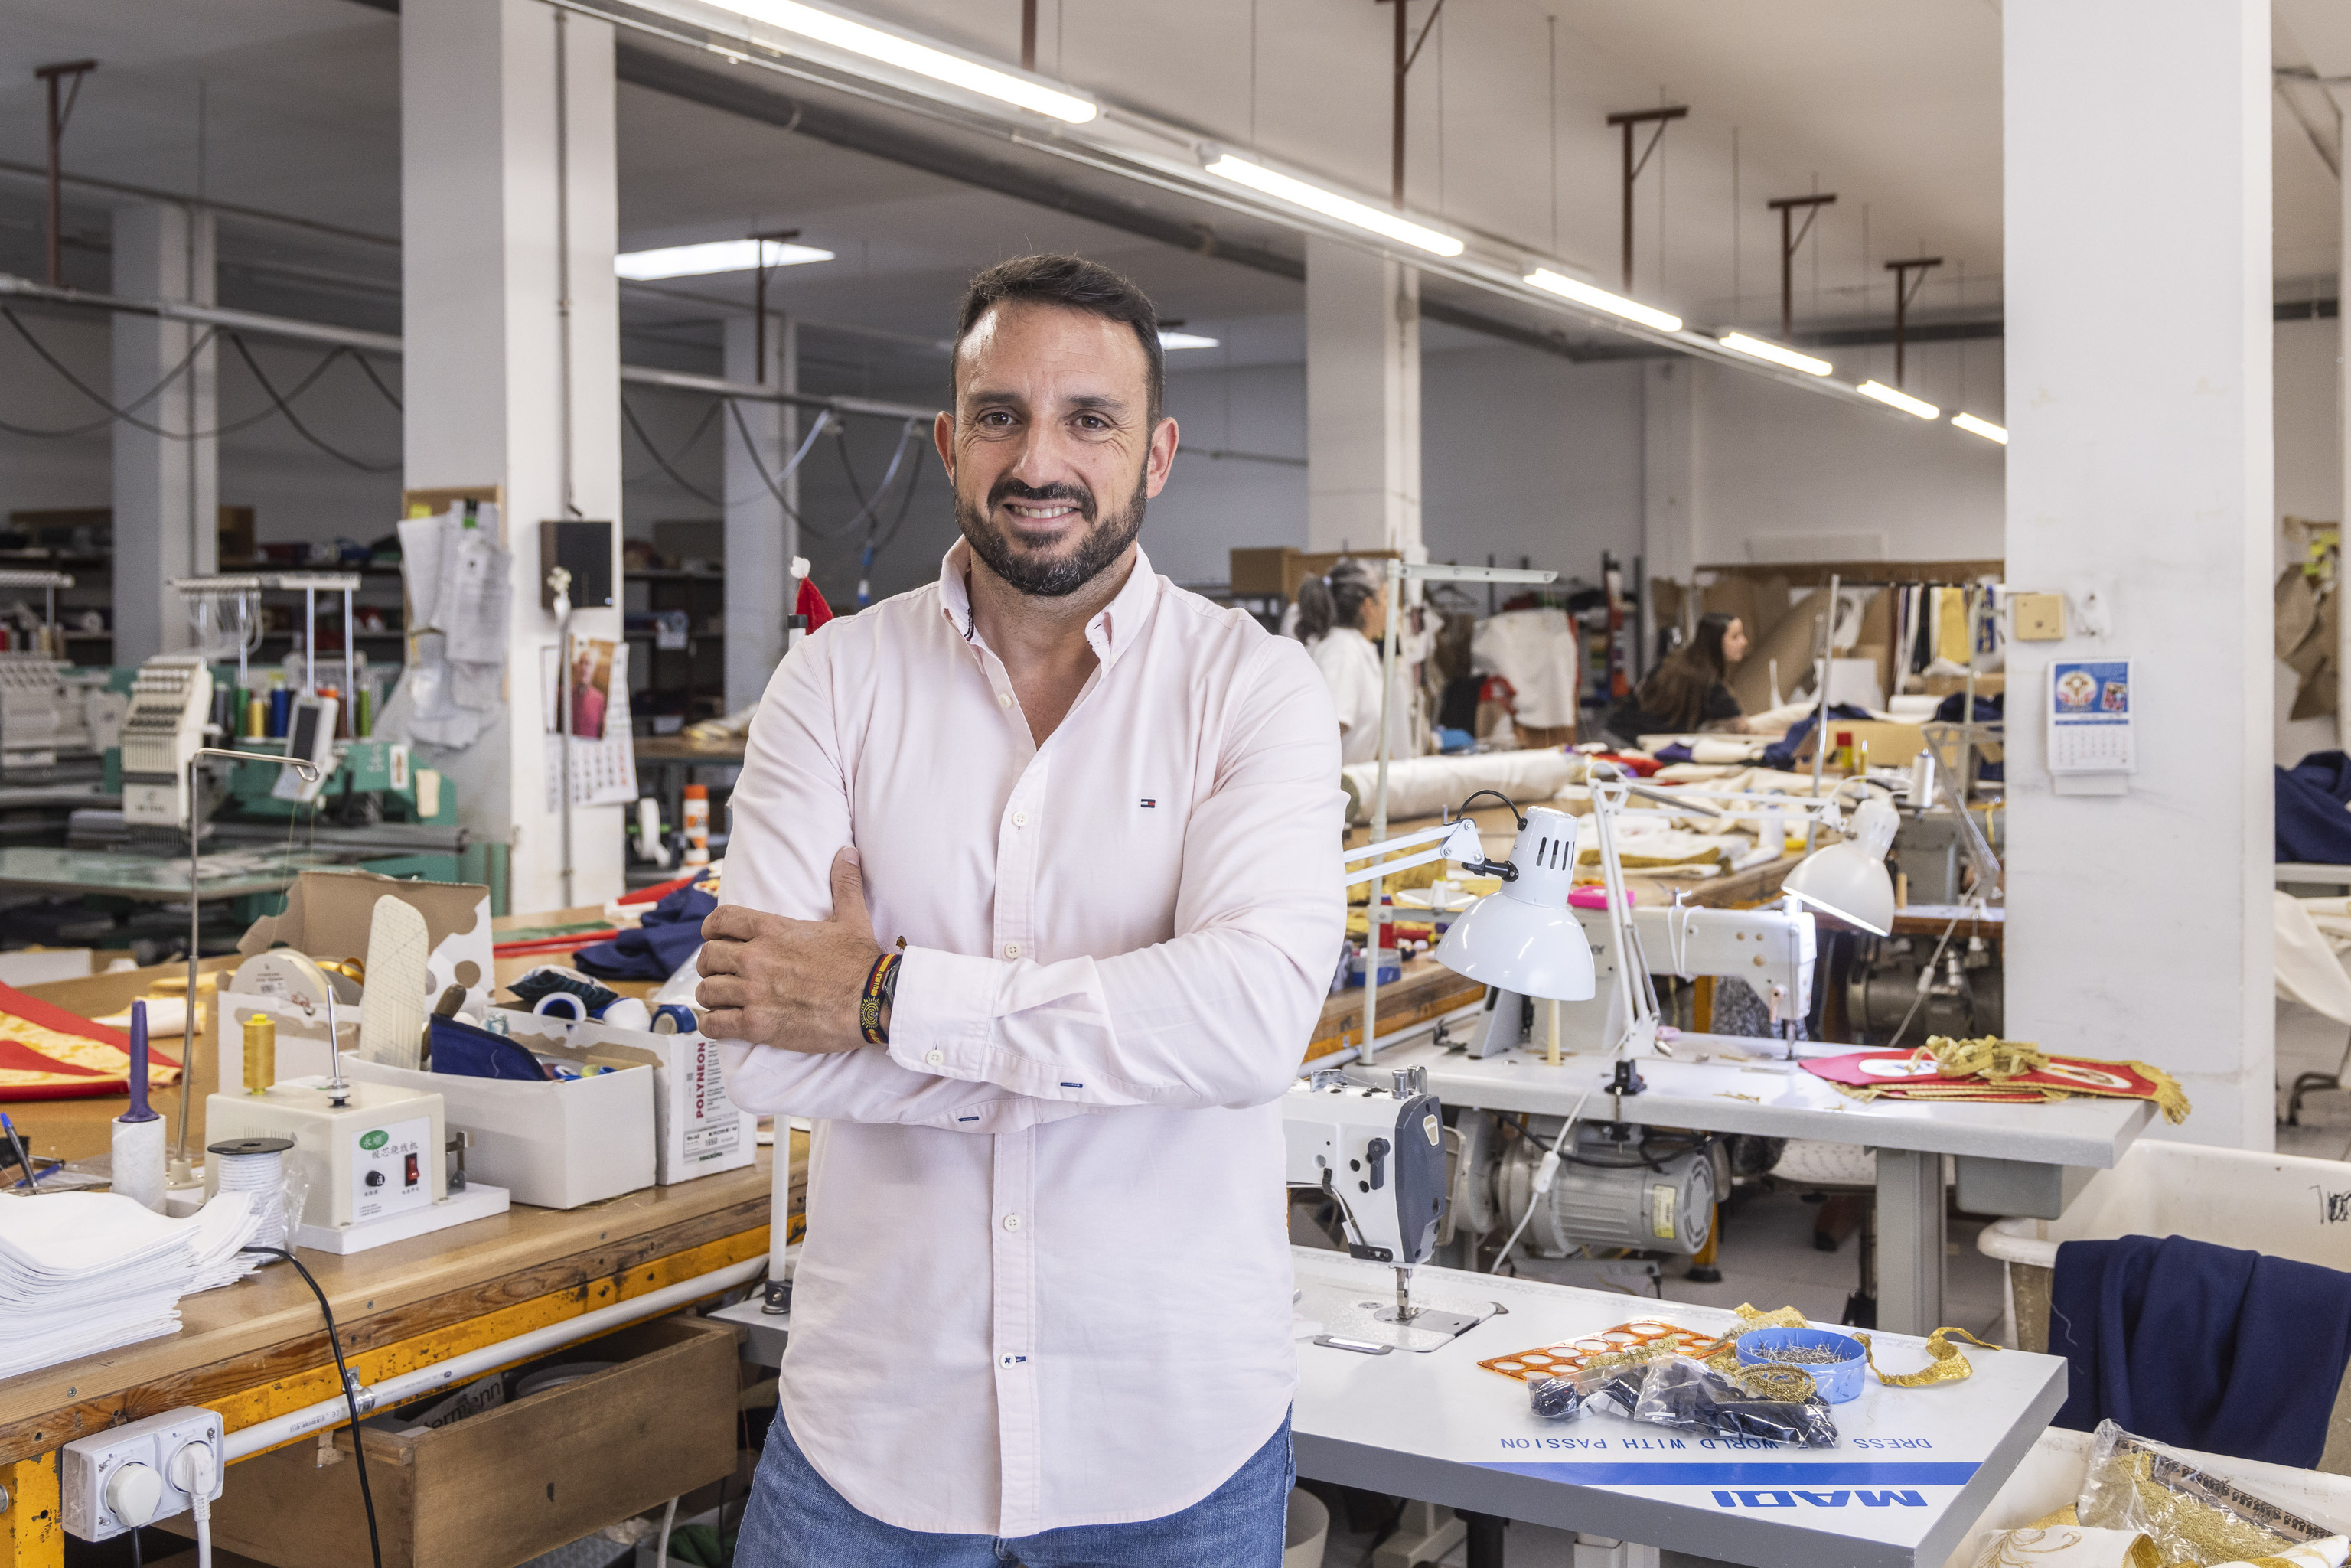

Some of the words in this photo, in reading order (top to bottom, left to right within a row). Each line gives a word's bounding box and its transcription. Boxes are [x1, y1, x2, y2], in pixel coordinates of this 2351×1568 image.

[872, 970, 884, 991] PILAR
[696, 1042, 706, 1119] POLYNEON
[1500, 1438, 1608, 1449] PASSION
[1622, 1438, 1686, 1449] WITH
[1700, 1438, 1780, 1449] WORLD
[1852, 1438, 1932, 1449] DRESS
[1711, 1489, 1929, 1508] MAQI
